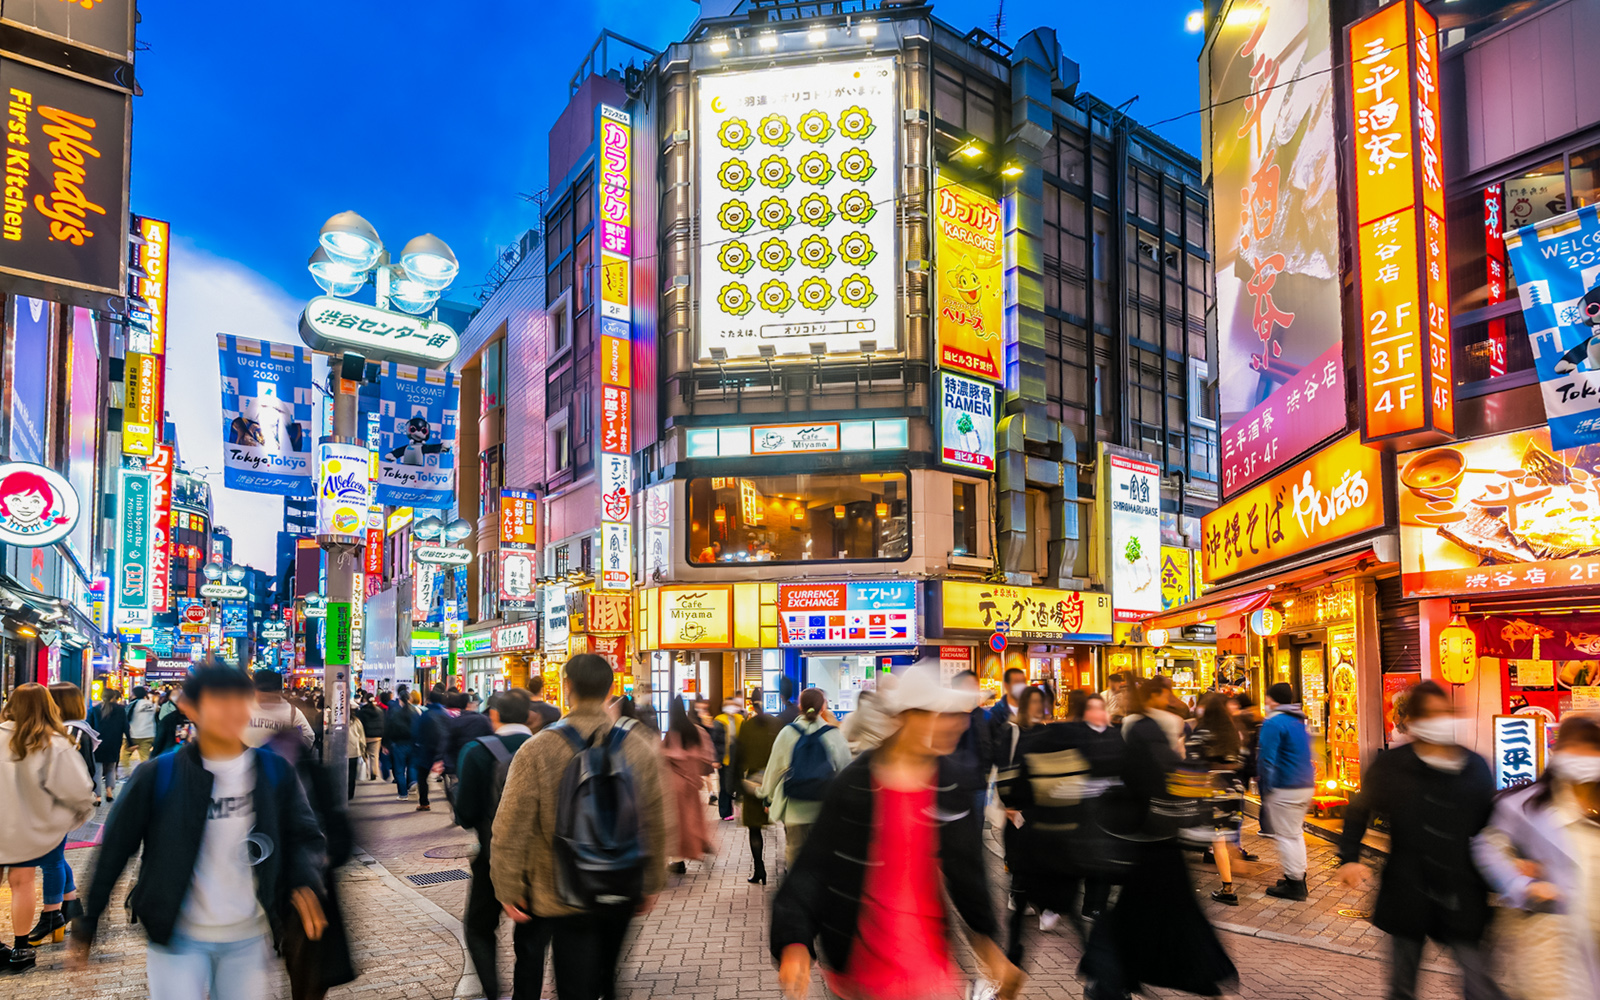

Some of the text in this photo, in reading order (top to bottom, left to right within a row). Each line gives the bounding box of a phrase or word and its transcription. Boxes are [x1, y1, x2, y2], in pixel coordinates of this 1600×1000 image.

[3, 87, 32, 241] First Kitchen
[34, 104, 107, 246] Wendy's
[603, 122, 628, 222] カラオケ
[939, 188, 1000, 234] カラオケ
[605, 223, 626, 239] 受付
[605, 235, 627, 251] 3F
[944, 222, 996, 253] KARAOKE
[1373, 215, 1402, 284] 渋谷店
[1429, 214, 1440, 282] 渋谷店
[617, 266, 625, 298] Miyama
[609, 305, 621, 314] 2F
[1369, 302, 1412, 335] 2F
[1429, 302, 1445, 330] 2F
[315, 309, 451, 349] 渋谷センター街
[719, 323, 827, 339] こたえは、 オリコトリ
[611, 339, 619, 382] Exchange
[1372, 343, 1414, 375] 3F
[1432, 344, 1447, 371] 3F
[253, 370, 280, 382] 2020
[944, 376, 992, 403] 特濃豚骨
[1286, 360, 1337, 414] 渋谷店
[406, 394, 434, 406] 2020
[944, 392, 992, 418] RAMEN
[1373, 384, 1416, 413] 4F
[1433, 385, 1448, 411] 4F
[1556, 380, 1600, 403] Tok
[793, 440, 828, 450] Miyama
[801, 433, 819, 441] Cafe
[954, 450, 985, 465] 当ビル 1F
[1120, 473, 1150, 503] 一風堂
[136, 493, 144, 511] Irish
[133, 516, 144, 536] Sport
[504, 508, 514, 541] もんじゃ
[514, 499, 524, 535] お好み焼
[1205, 469, 1369, 569] 沖縄そば やんばる
[135, 536, 143, 548] Bar
[609, 526, 624, 570] 一風堂
[1465, 564, 1600, 588] 渋谷店 2F
[681, 601, 703, 609] Cafe
[787, 589, 840, 599] CURRENCY
[787, 598, 840, 608] EXCHANGE
[857, 588, 901, 601] エアトリ
[1097, 596, 1109, 608] B1
[128, 610, 140, 619] B1
[593, 595, 628, 630] 豚
[671, 610, 713, 620] Miyama
[979, 591, 1064, 629] テング酒場
[1462, 637, 1473, 675] ホッピー
